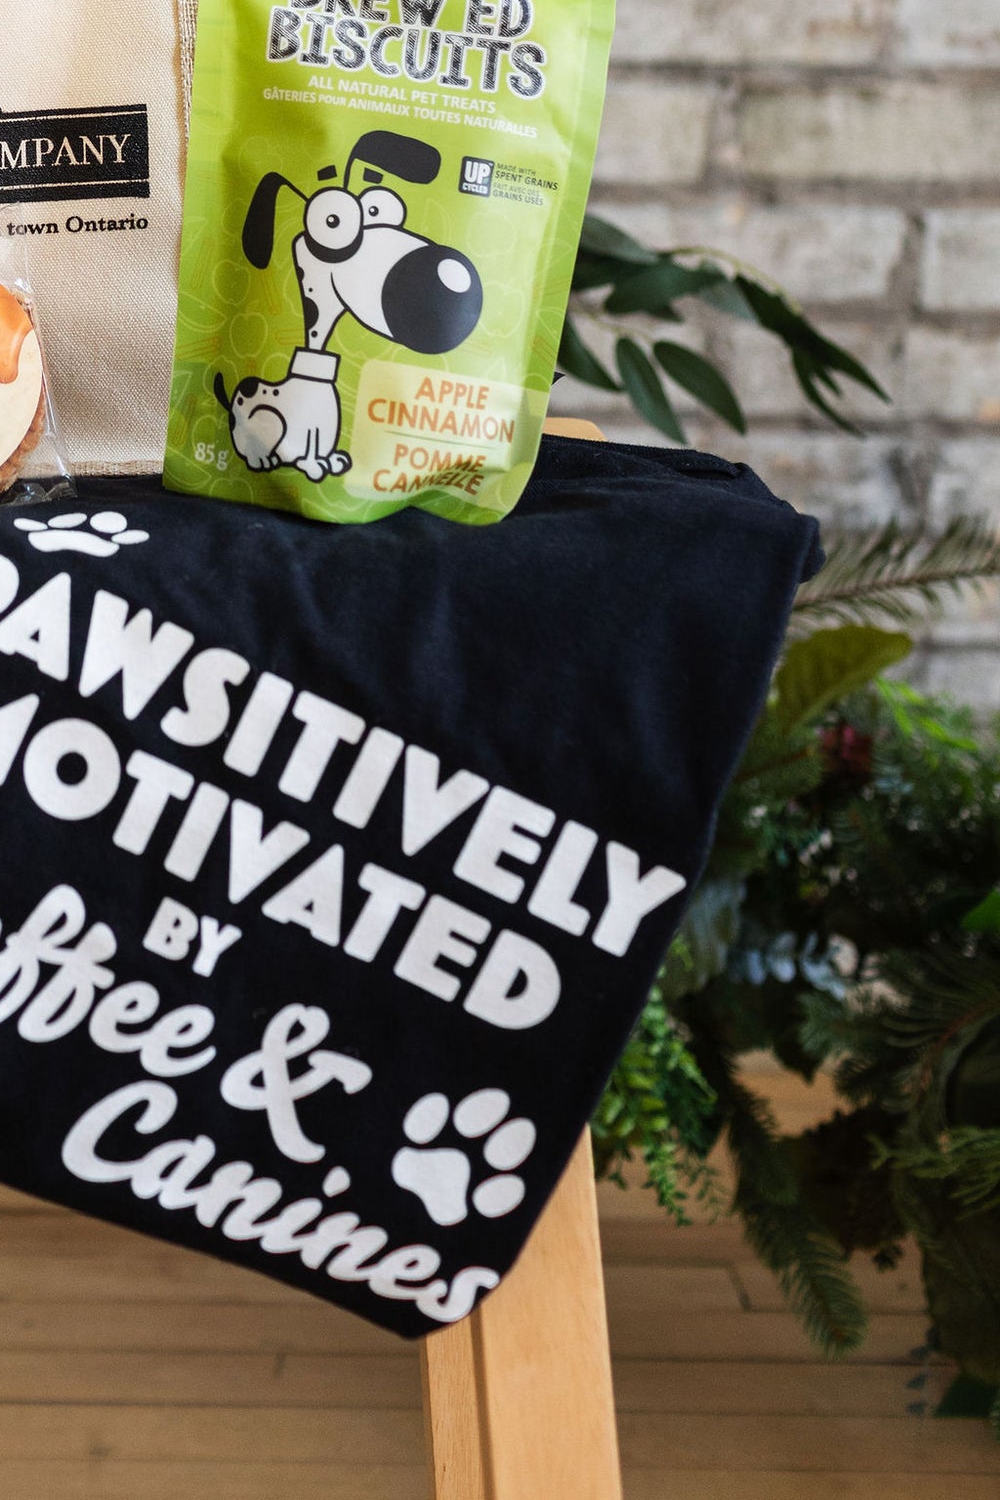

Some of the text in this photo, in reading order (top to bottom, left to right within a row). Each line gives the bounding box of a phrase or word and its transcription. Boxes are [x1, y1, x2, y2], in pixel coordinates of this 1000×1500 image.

[266, 7, 547, 100] BISCUITS
[263, 86, 316, 103] GÂTERIES
[318, 94, 346, 106] POUR
[348, 98, 410, 116] ANIMAUX
[413, 106, 460, 124] TOUTES
[308, 75, 496, 114] ALL NATURAL PET TREATS
[464, 160, 491, 185] UP
[495, 170, 559, 190] SPENT GRAINS
[492, 189, 523, 202] GRAINS
[7, 220, 59, 237] town
[65, 213, 149, 233] Ontario
[415, 376, 489, 410] APPLE
[368, 398, 515, 444] CINNAMON
[194, 442, 215, 464] 85
[393, 443, 486, 473] POMME
[142, 897, 242, 977] BY
[220, 1002, 373, 1163] &
[61, 1081, 500, 1323] Canines
